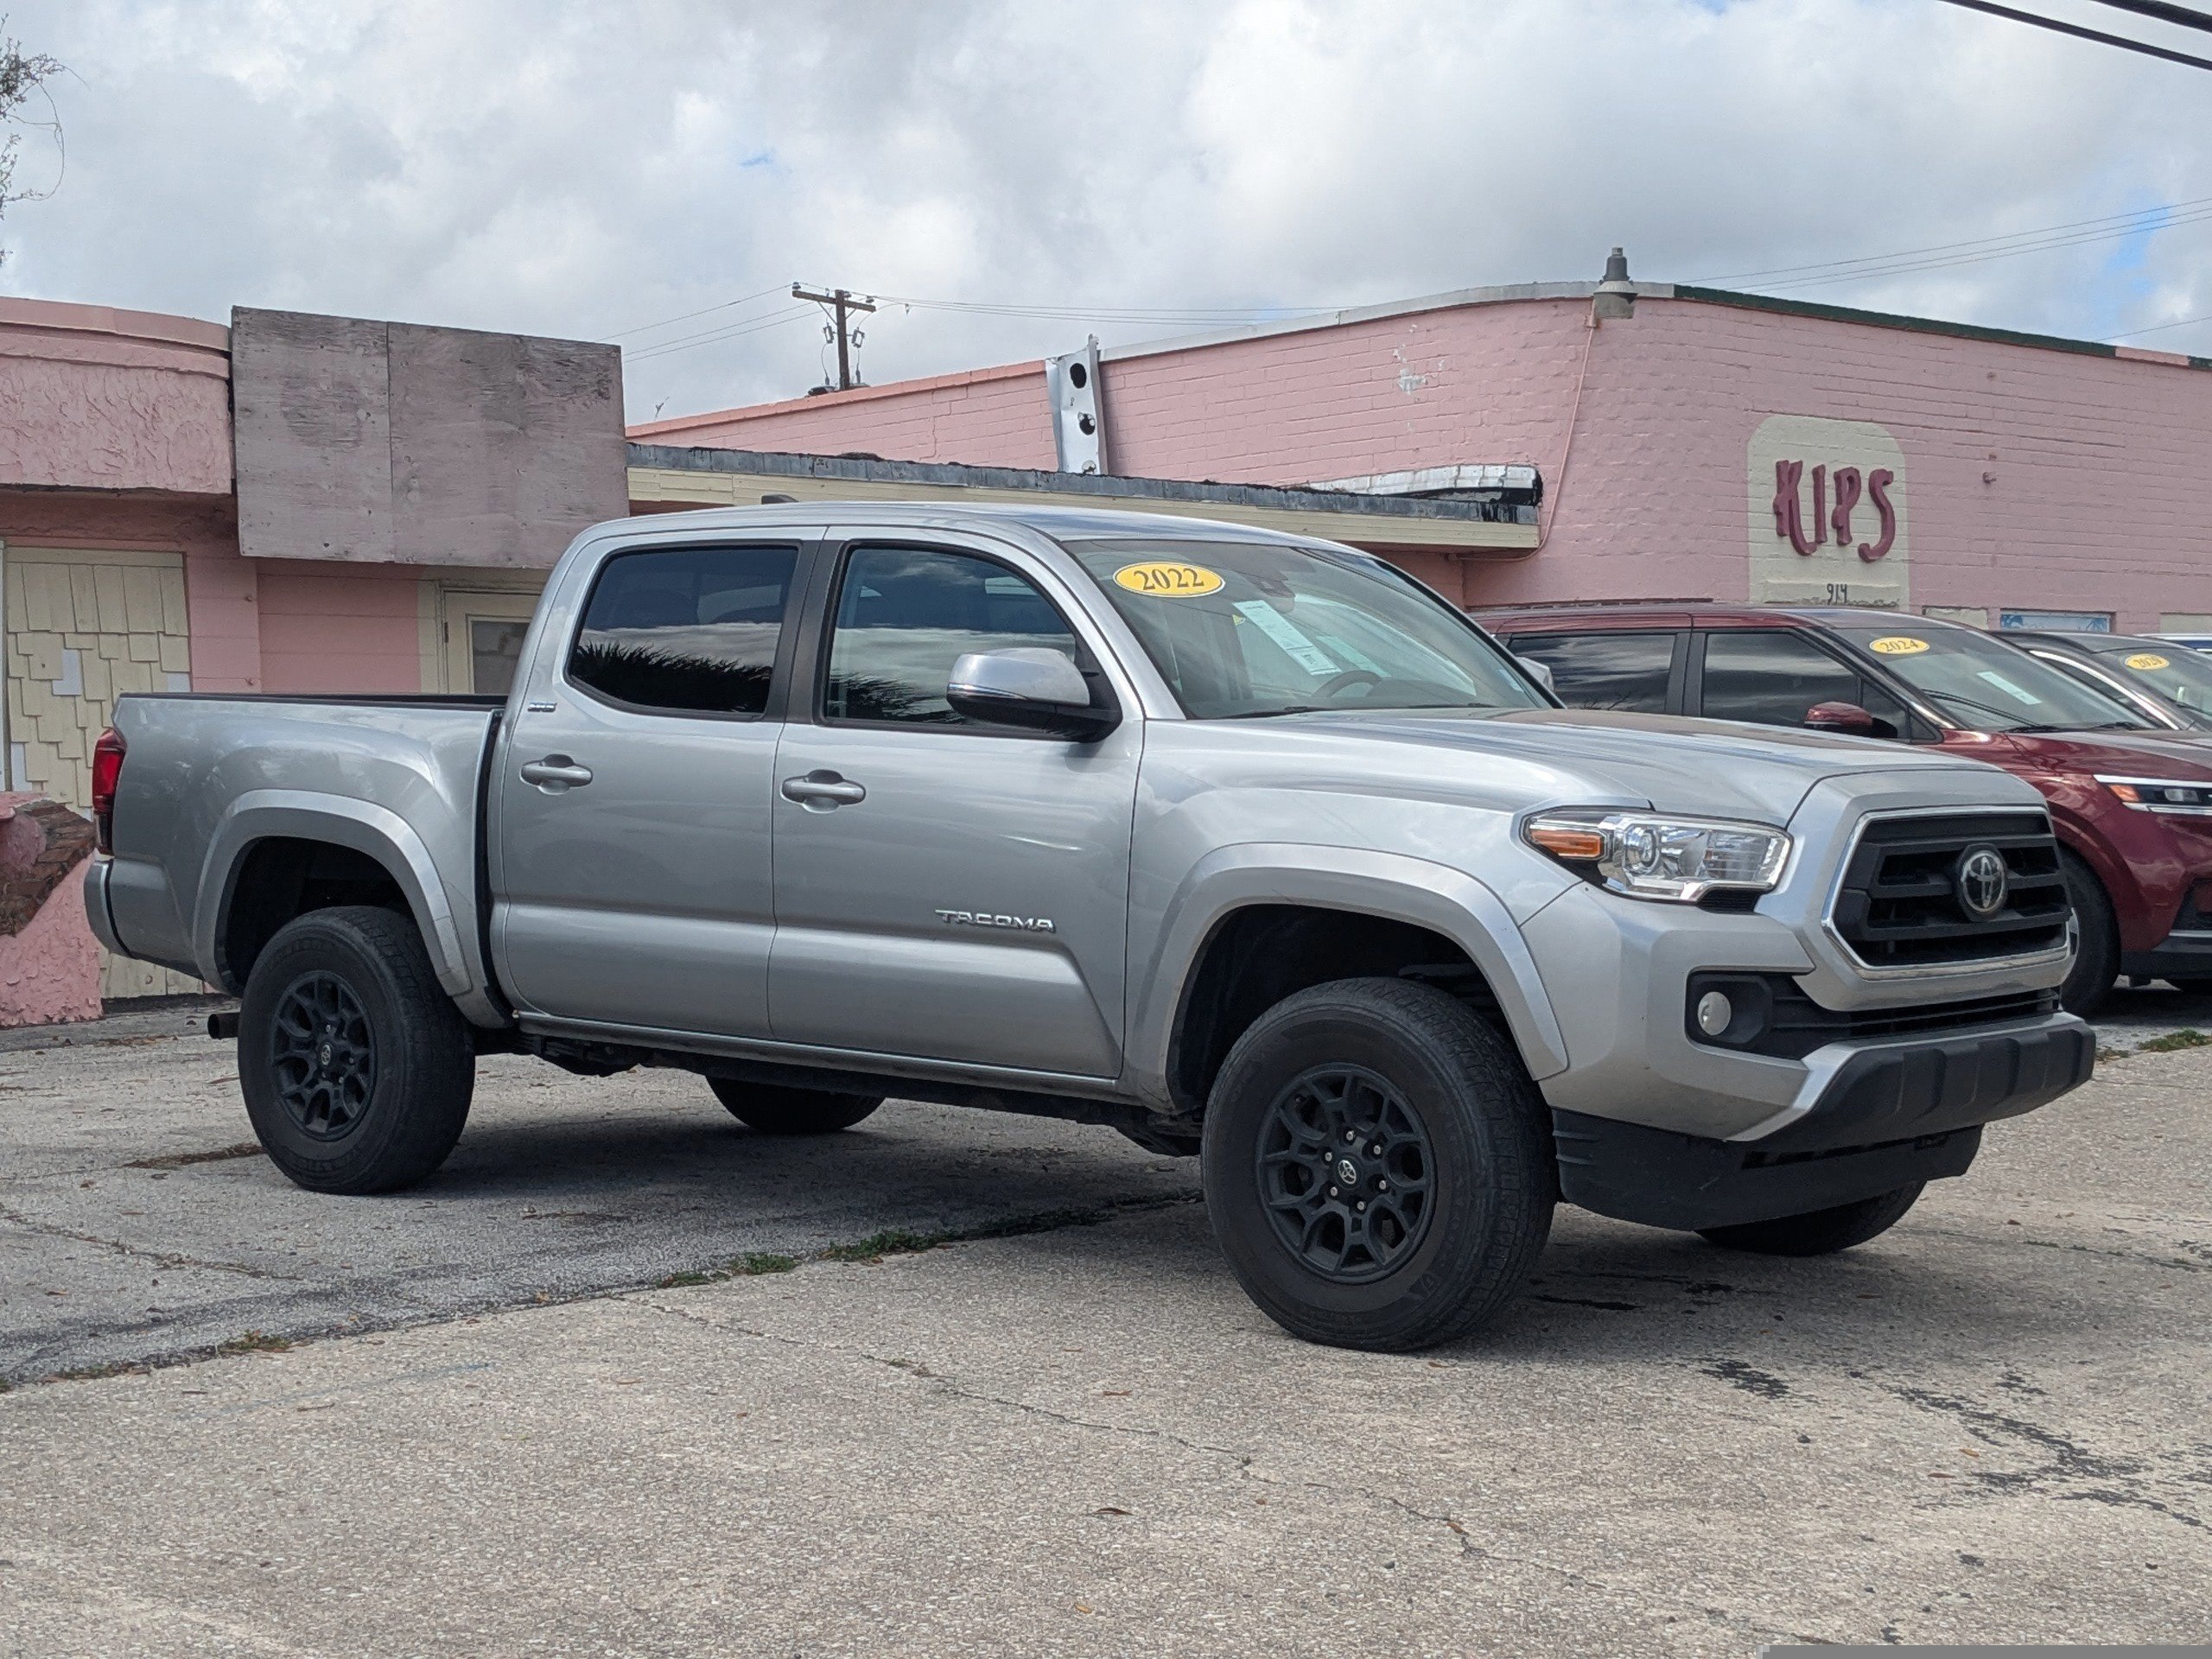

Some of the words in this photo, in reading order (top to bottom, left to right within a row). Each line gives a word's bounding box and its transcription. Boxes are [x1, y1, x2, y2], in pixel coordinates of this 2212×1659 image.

[1773, 459, 1896, 563] KIPS
[1133, 567, 1205, 591] 2022
[1826, 582, 1848, 605] 914
[1879, 639, 1919, 652] 2024
[935, 909, 1057, 933] TACOMA
